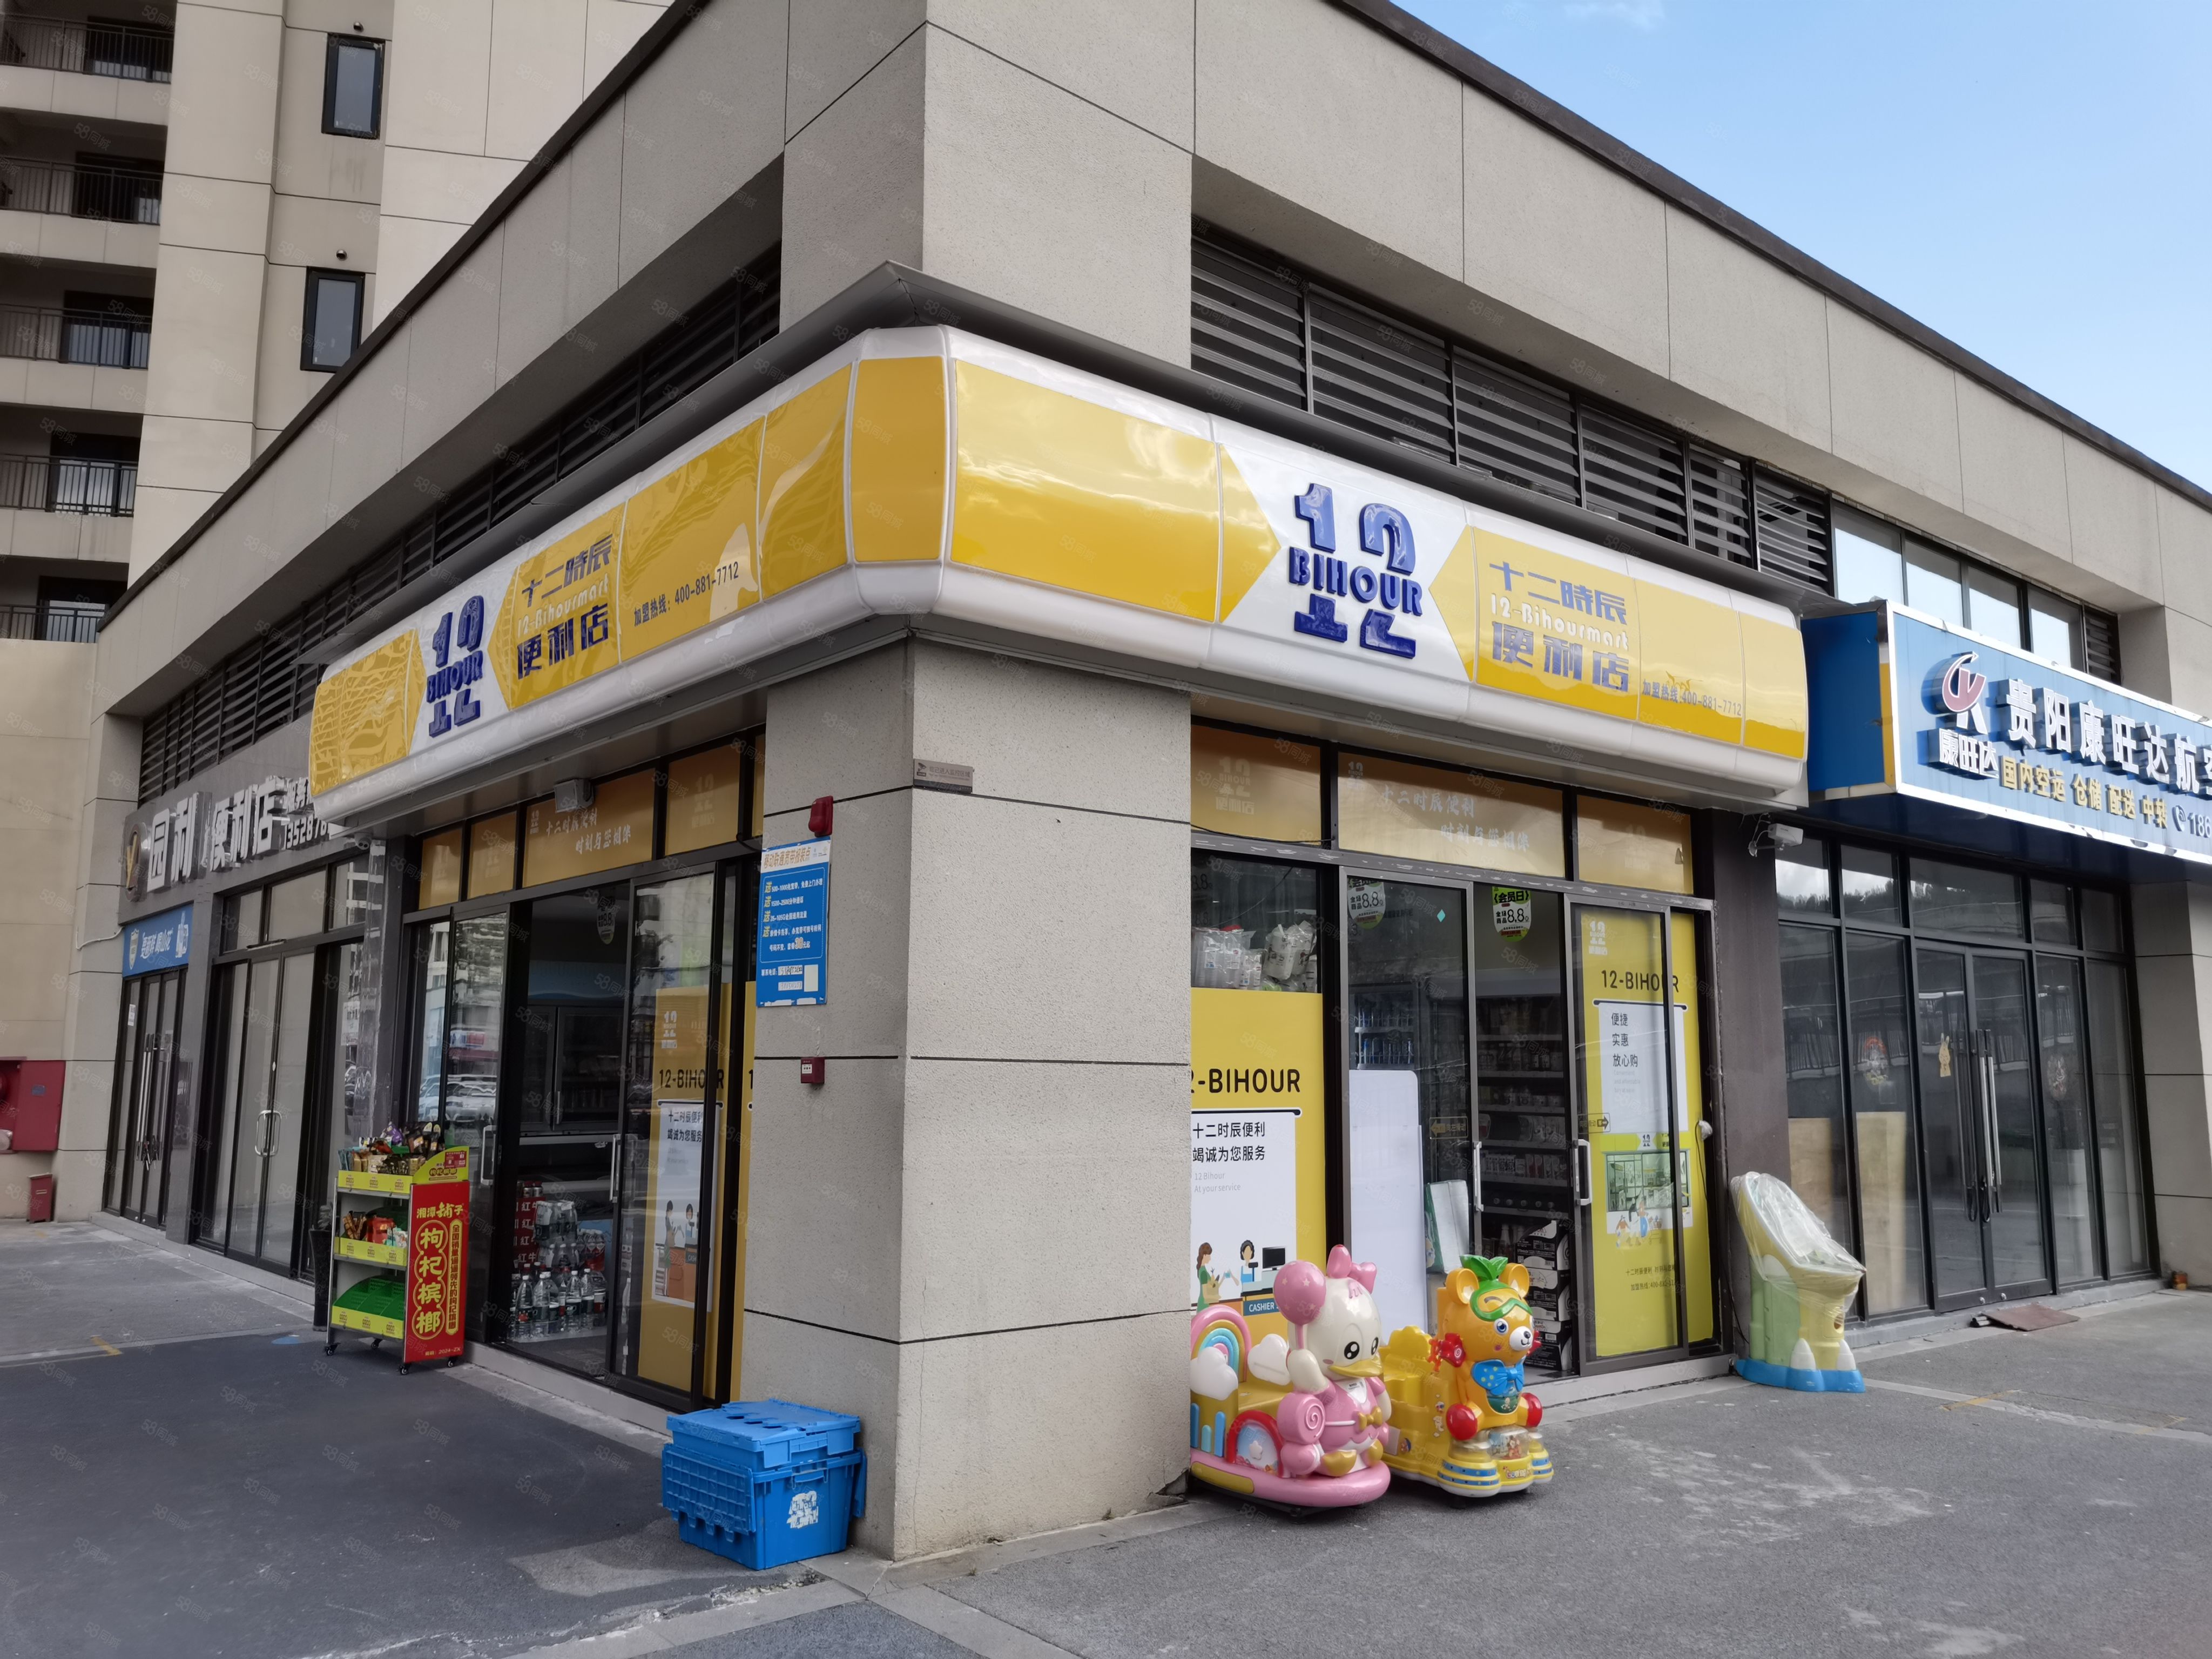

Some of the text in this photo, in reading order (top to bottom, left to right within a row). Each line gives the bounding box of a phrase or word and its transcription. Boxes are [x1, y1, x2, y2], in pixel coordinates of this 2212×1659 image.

[522, 534, 612, 607] 十二時辰
[1289, 546, 1423, 616] BIHOUR
[1489, 561, 1627, 625] 十二時辰
[518, 573, 611, 637] 12-Bihourmart
[1491, 593, 1629, 651] 12-Bihourmart
[517, 602, 609, 680] 便利店
[1491, 621, 1629, 692] 便利店
[426, 650, 484, 703] BIHOUR
[1939, 727, 1999, 779] 康旺达
[2002, 756, 2067, 802] 国内空运
[2071, 773, 2102, 811] 仓储
[2107, 784, 2136, 820] 配送
[2140, 794, 2168, 829] 中转
[1601, 970, 1678, 993] 12-BIHOR
[1611, 1013, 1628, 1027] 便捷
[1612, 1033, 1629, 1047] 实惠
[659, 1069, 724, 1089] 12-BIHOR
[1613, 1054, 1638, 1068] 放心购
[1192, 1121, 1265, 1139] 十二时辰便利
[1192, 1145, 1265, 1163] 竭诚为您服务
[1194, 1171, 1225, 1181] 12 Bihour
[1194, 1183, 1241, 1195] At your service
[416, 1228, 444, 1334] 枸杞槟榔
[1249, 1301, 1274, 1312] CASHIER
